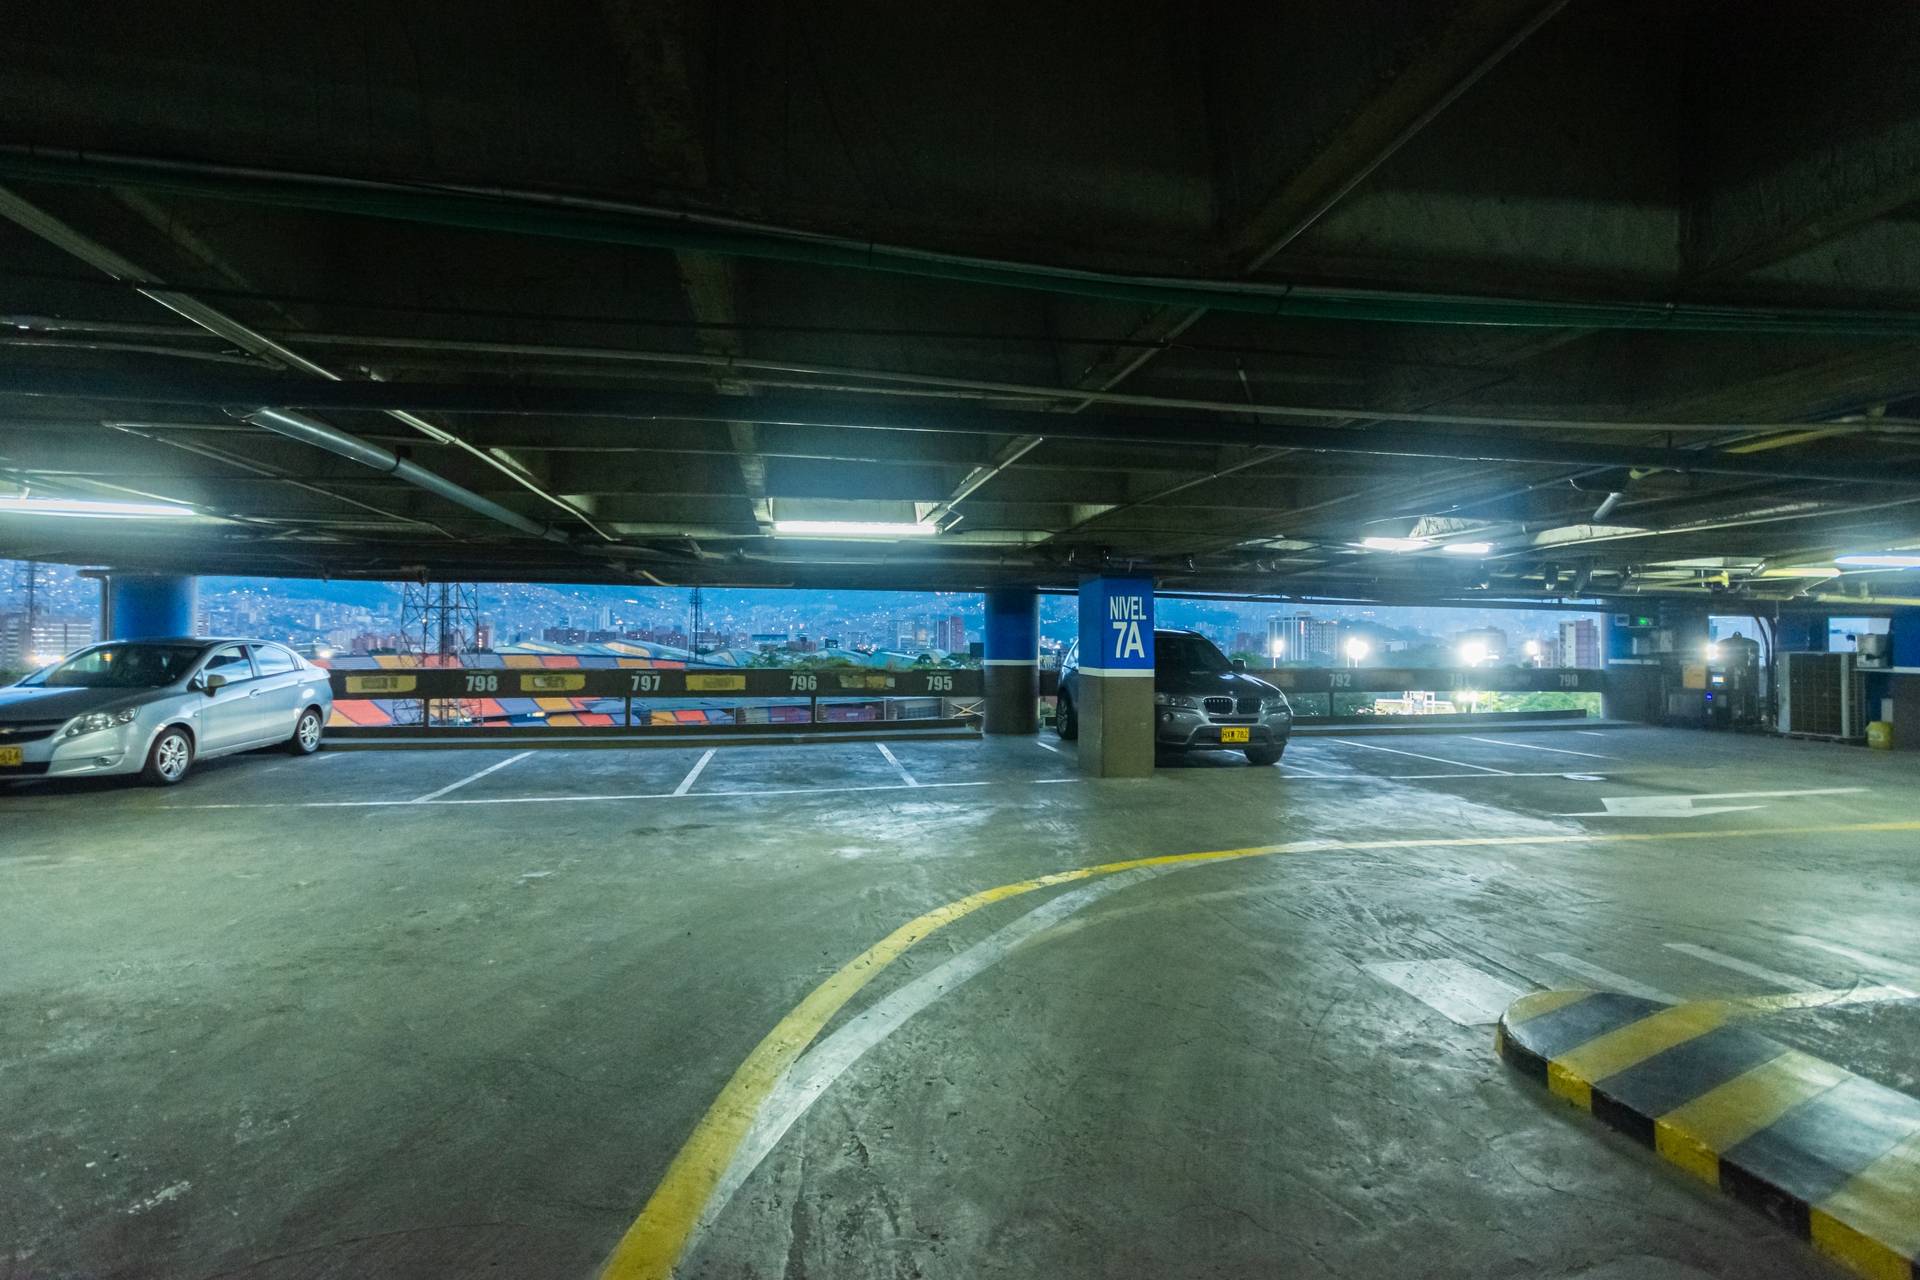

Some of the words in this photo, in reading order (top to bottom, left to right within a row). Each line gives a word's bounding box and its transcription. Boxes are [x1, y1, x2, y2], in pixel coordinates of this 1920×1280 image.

[1110, 596, 1147, 620] NIVEL
[1113, 621, 1145, 658] 7A
[465, 675, 498, 692] 798
[631, 675, 661, 692] 797
[790, 675, 817, 691] 796
[926, 675, 953, 691] 795
[1329, 673, 1351, 687] 792
[1559, 673, 1579, 687] 790
